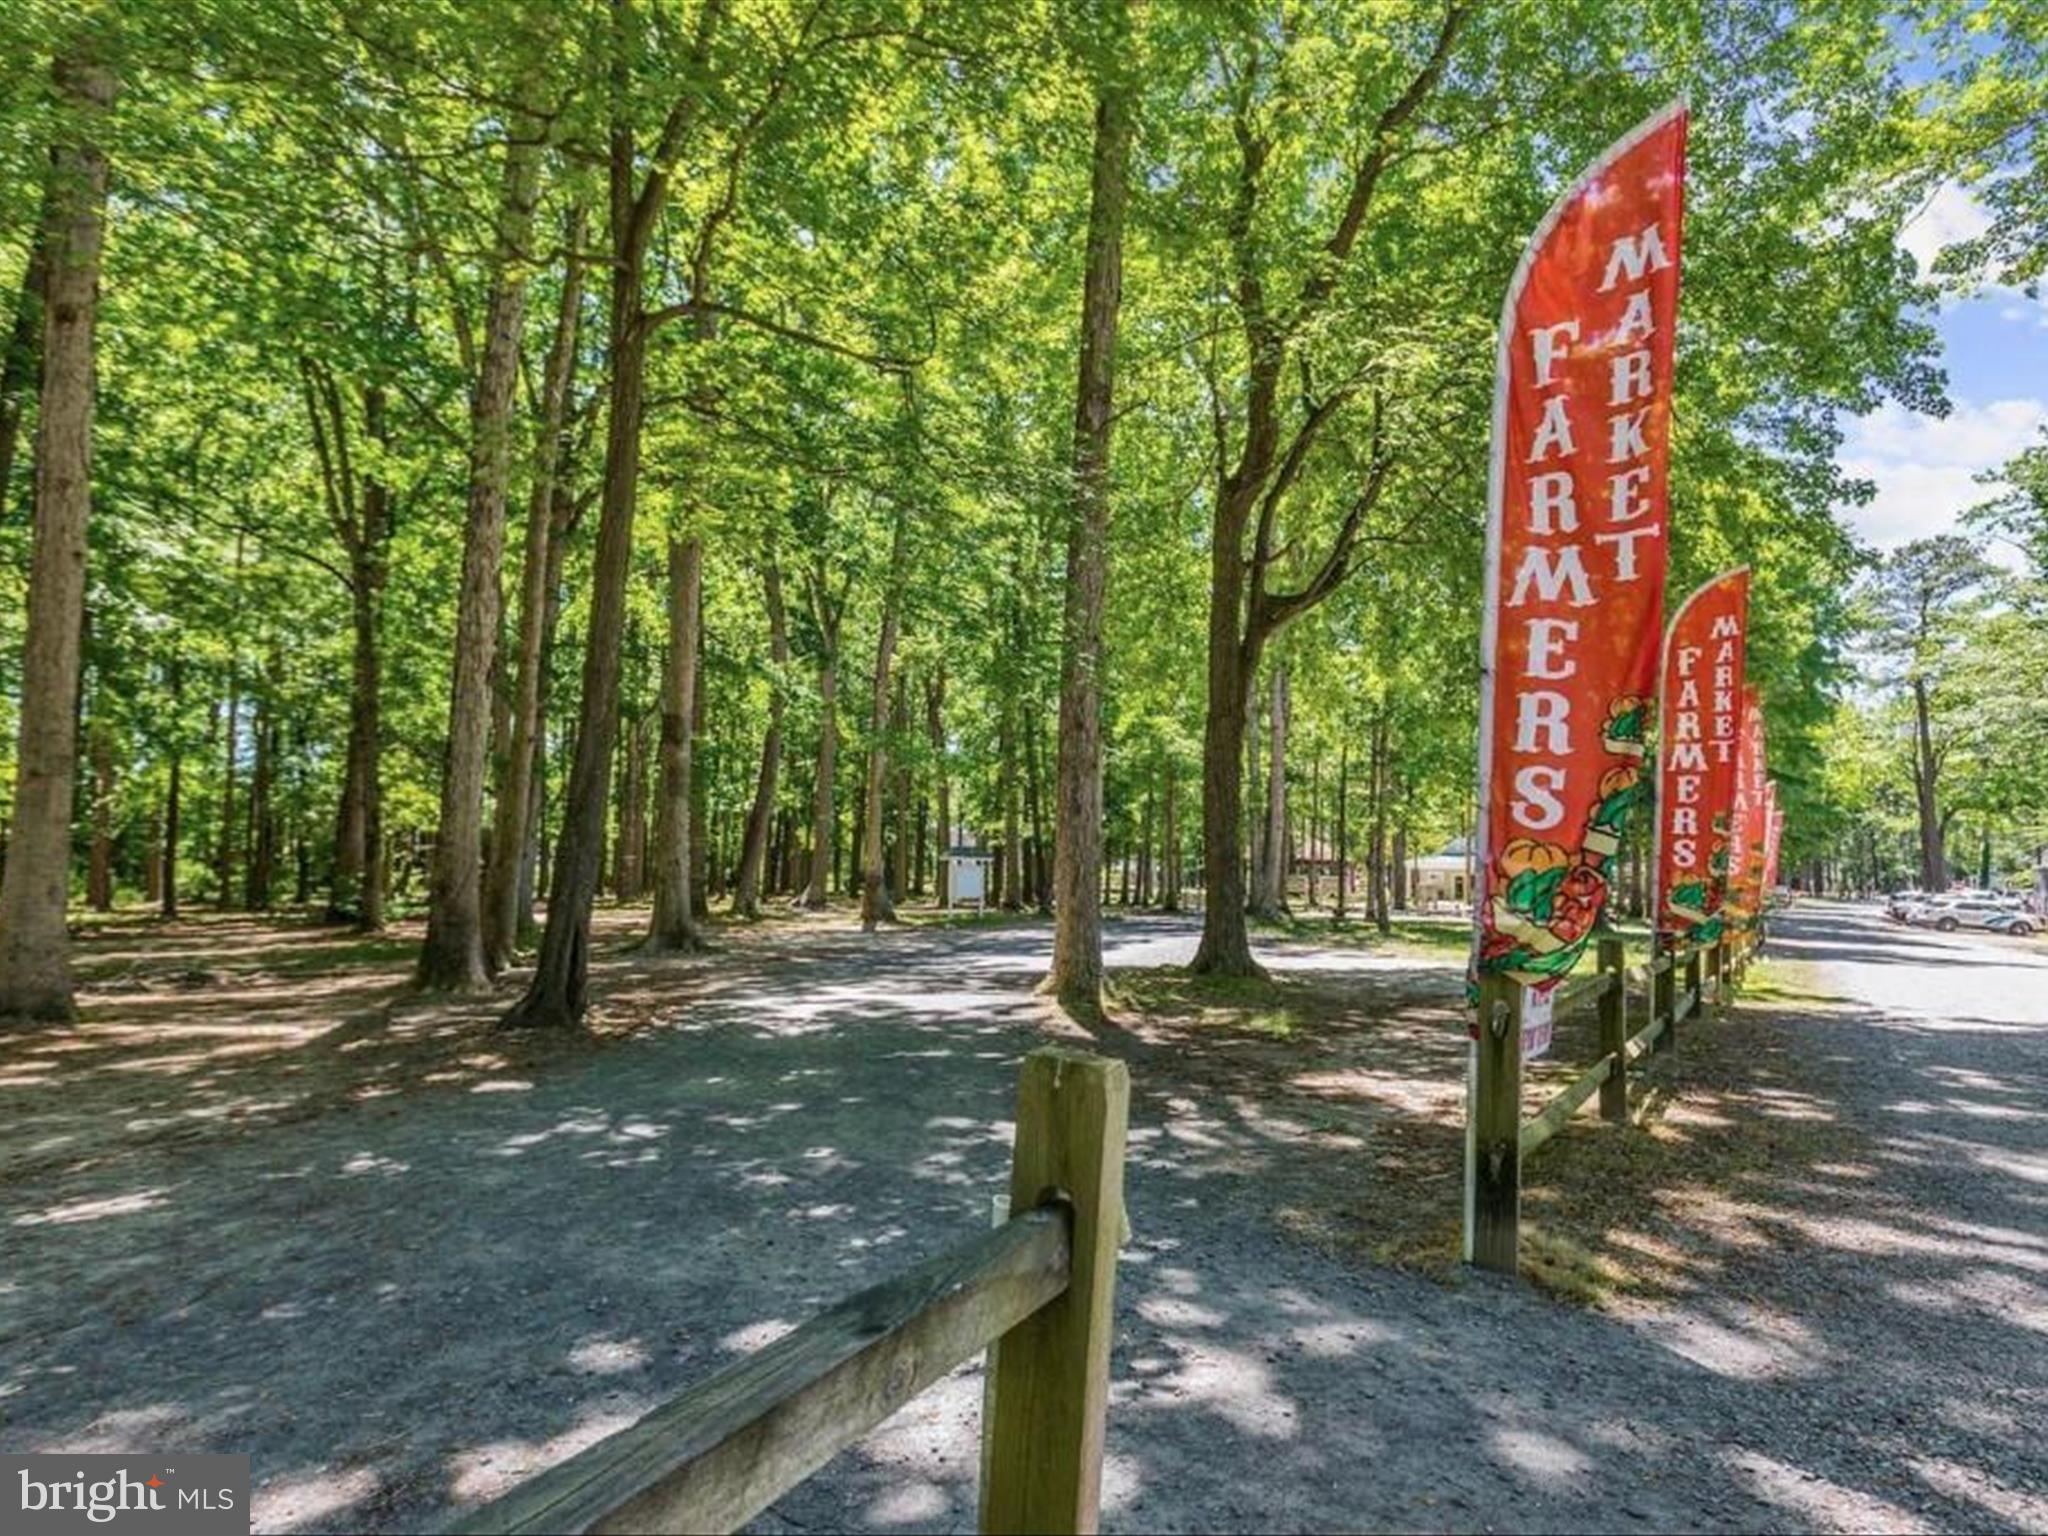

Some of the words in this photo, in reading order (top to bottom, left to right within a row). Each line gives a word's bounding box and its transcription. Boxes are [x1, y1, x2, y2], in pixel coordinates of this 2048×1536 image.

[1595, 222, 1673, 582] MARKET
[1504, 320, 1600, 831] FARMERS
[1708, 614, 1740, 764] MARKET
[1668, 646, 1709, 869] FARMERS
